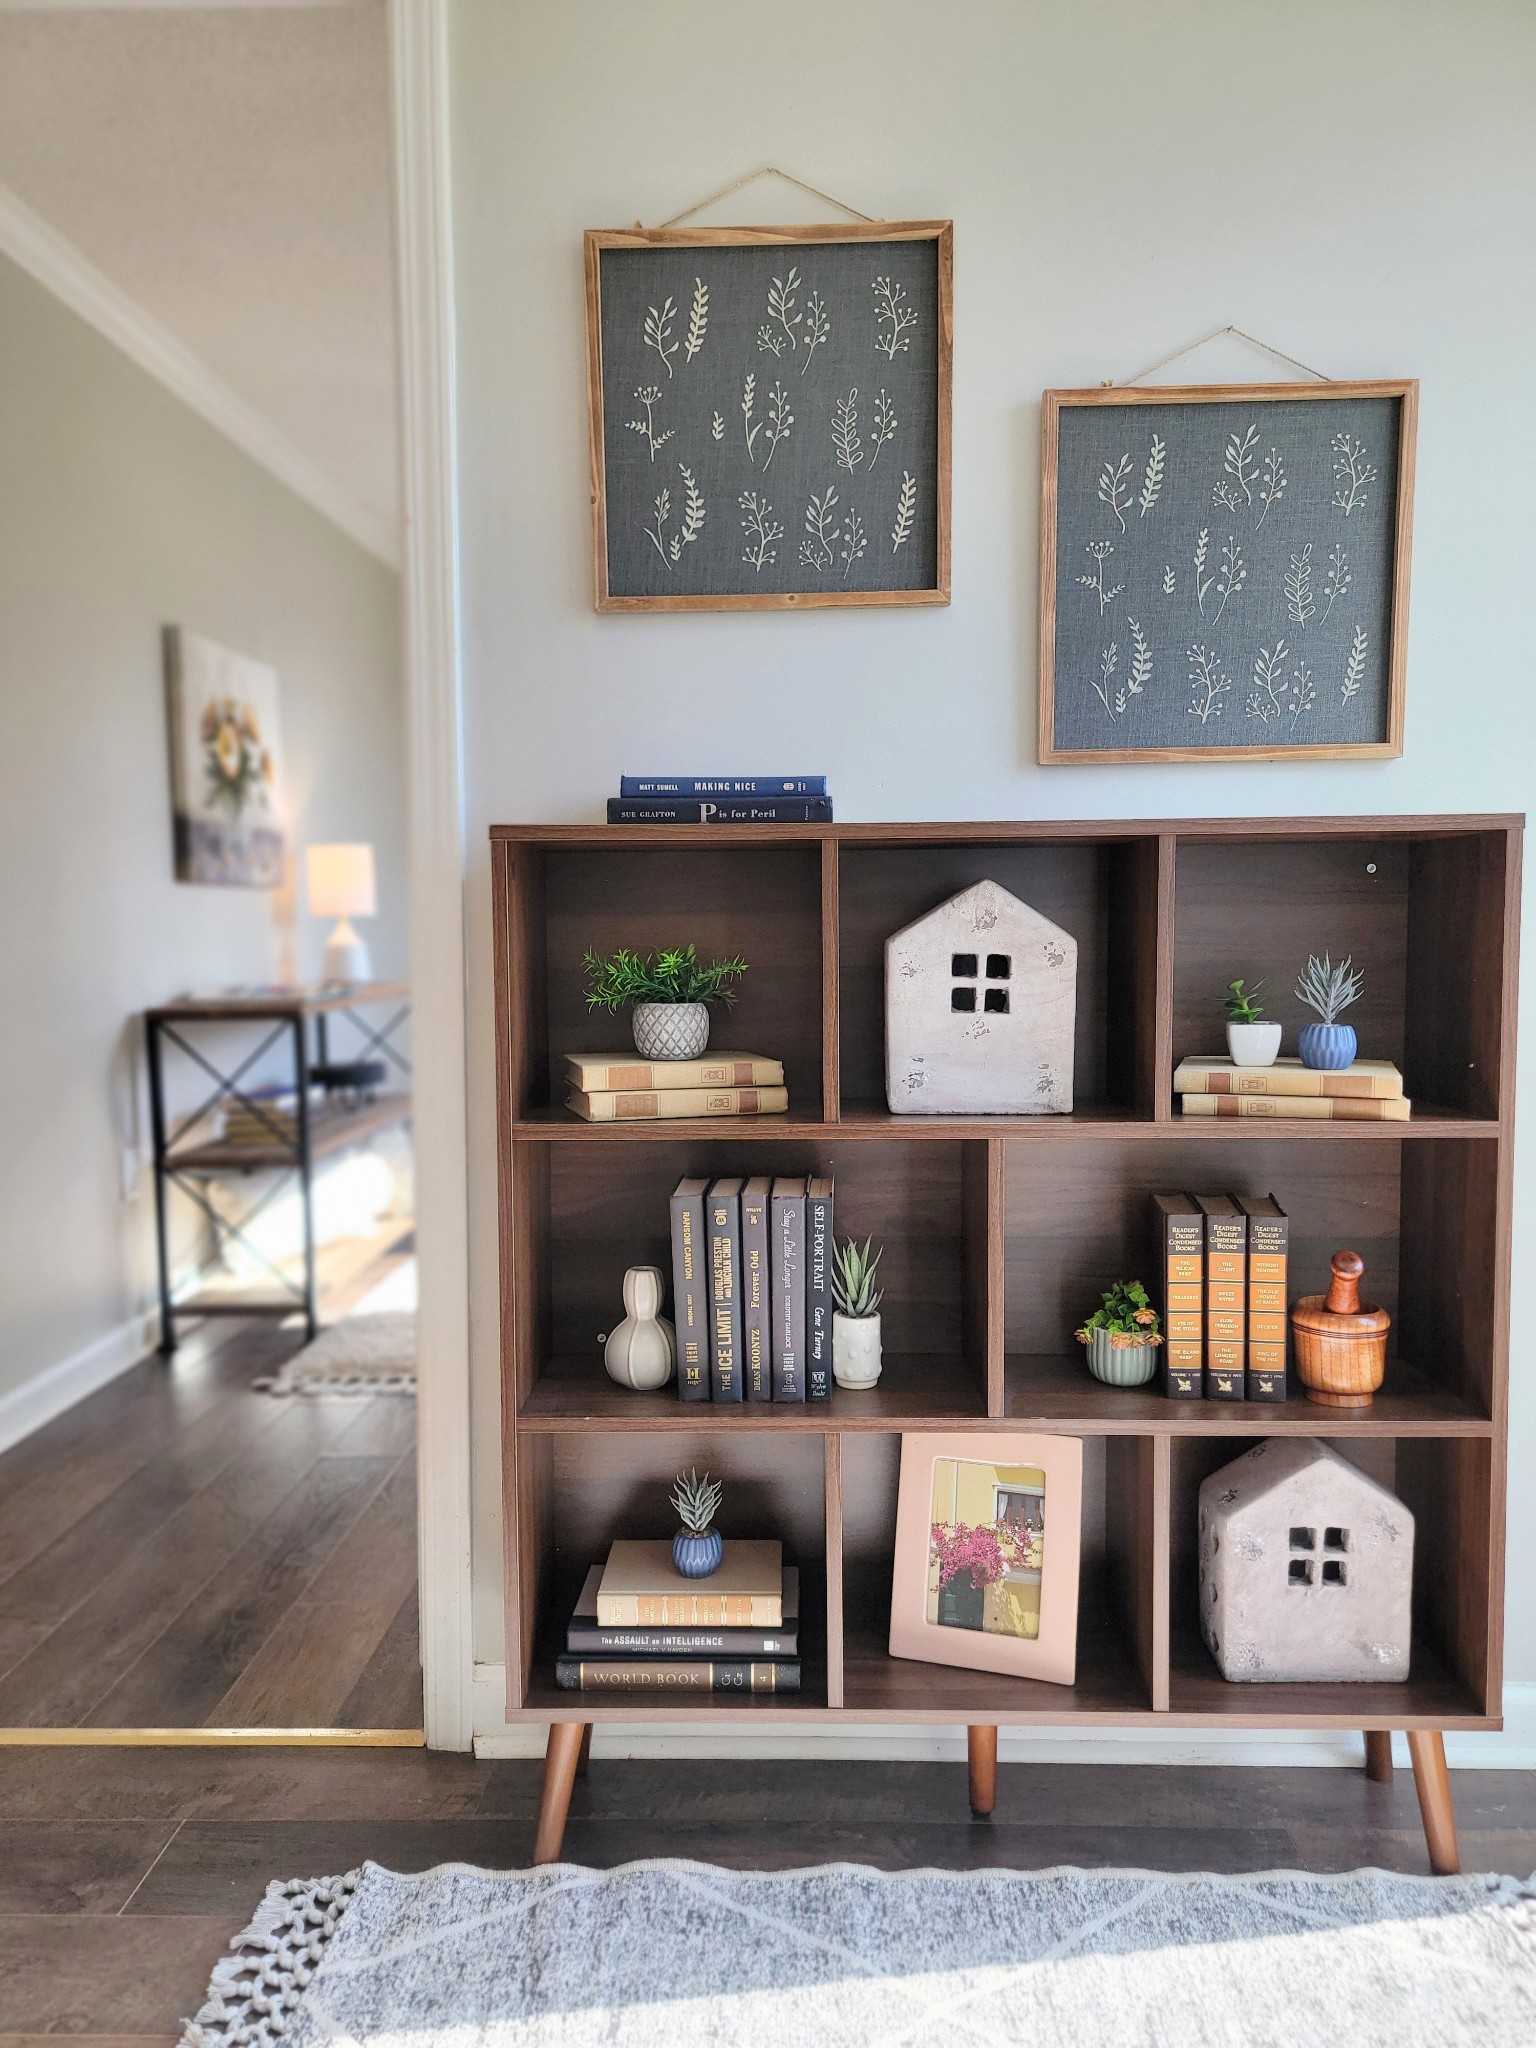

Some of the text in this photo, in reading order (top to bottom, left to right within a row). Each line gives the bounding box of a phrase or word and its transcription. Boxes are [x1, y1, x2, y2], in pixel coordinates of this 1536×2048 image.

[694, 782, 756, 791] MAKING NICE
[698, 803, 776, 823] P is for Peril
[780, 1209, 796, 1227] Stay
[1213, 1224, 1242, 1232] READER'S
[682, 1212, 692, 1280] RANSOM CANYON
[722, 1238, 732, 1258] CHILD
[783, 1236, 796, 1258] Little
[814, 1205, 824, 1292] SELF-PORTRAIT
[713, 1236, 723, 1300] DOUGLAS PRESTON
[723, 1260, 732, 1288] LINCOLN
[750, 1250, 760, 1308] Forever Odd
[782, 1260, 796, 1288] Longer
[812, 1307, 824, 1360] Gene Tierney
[716, 1308, 733, 1391] THE ICE LIMIT
[751, 1329, 760, 1370] KOONTZ
[614, 1636, 649, 1645] ASSAULT
[662, 1637, 723, 1646] INTELLIGENCE
[593, 1673, 699, 1684] WORLD BOOK
